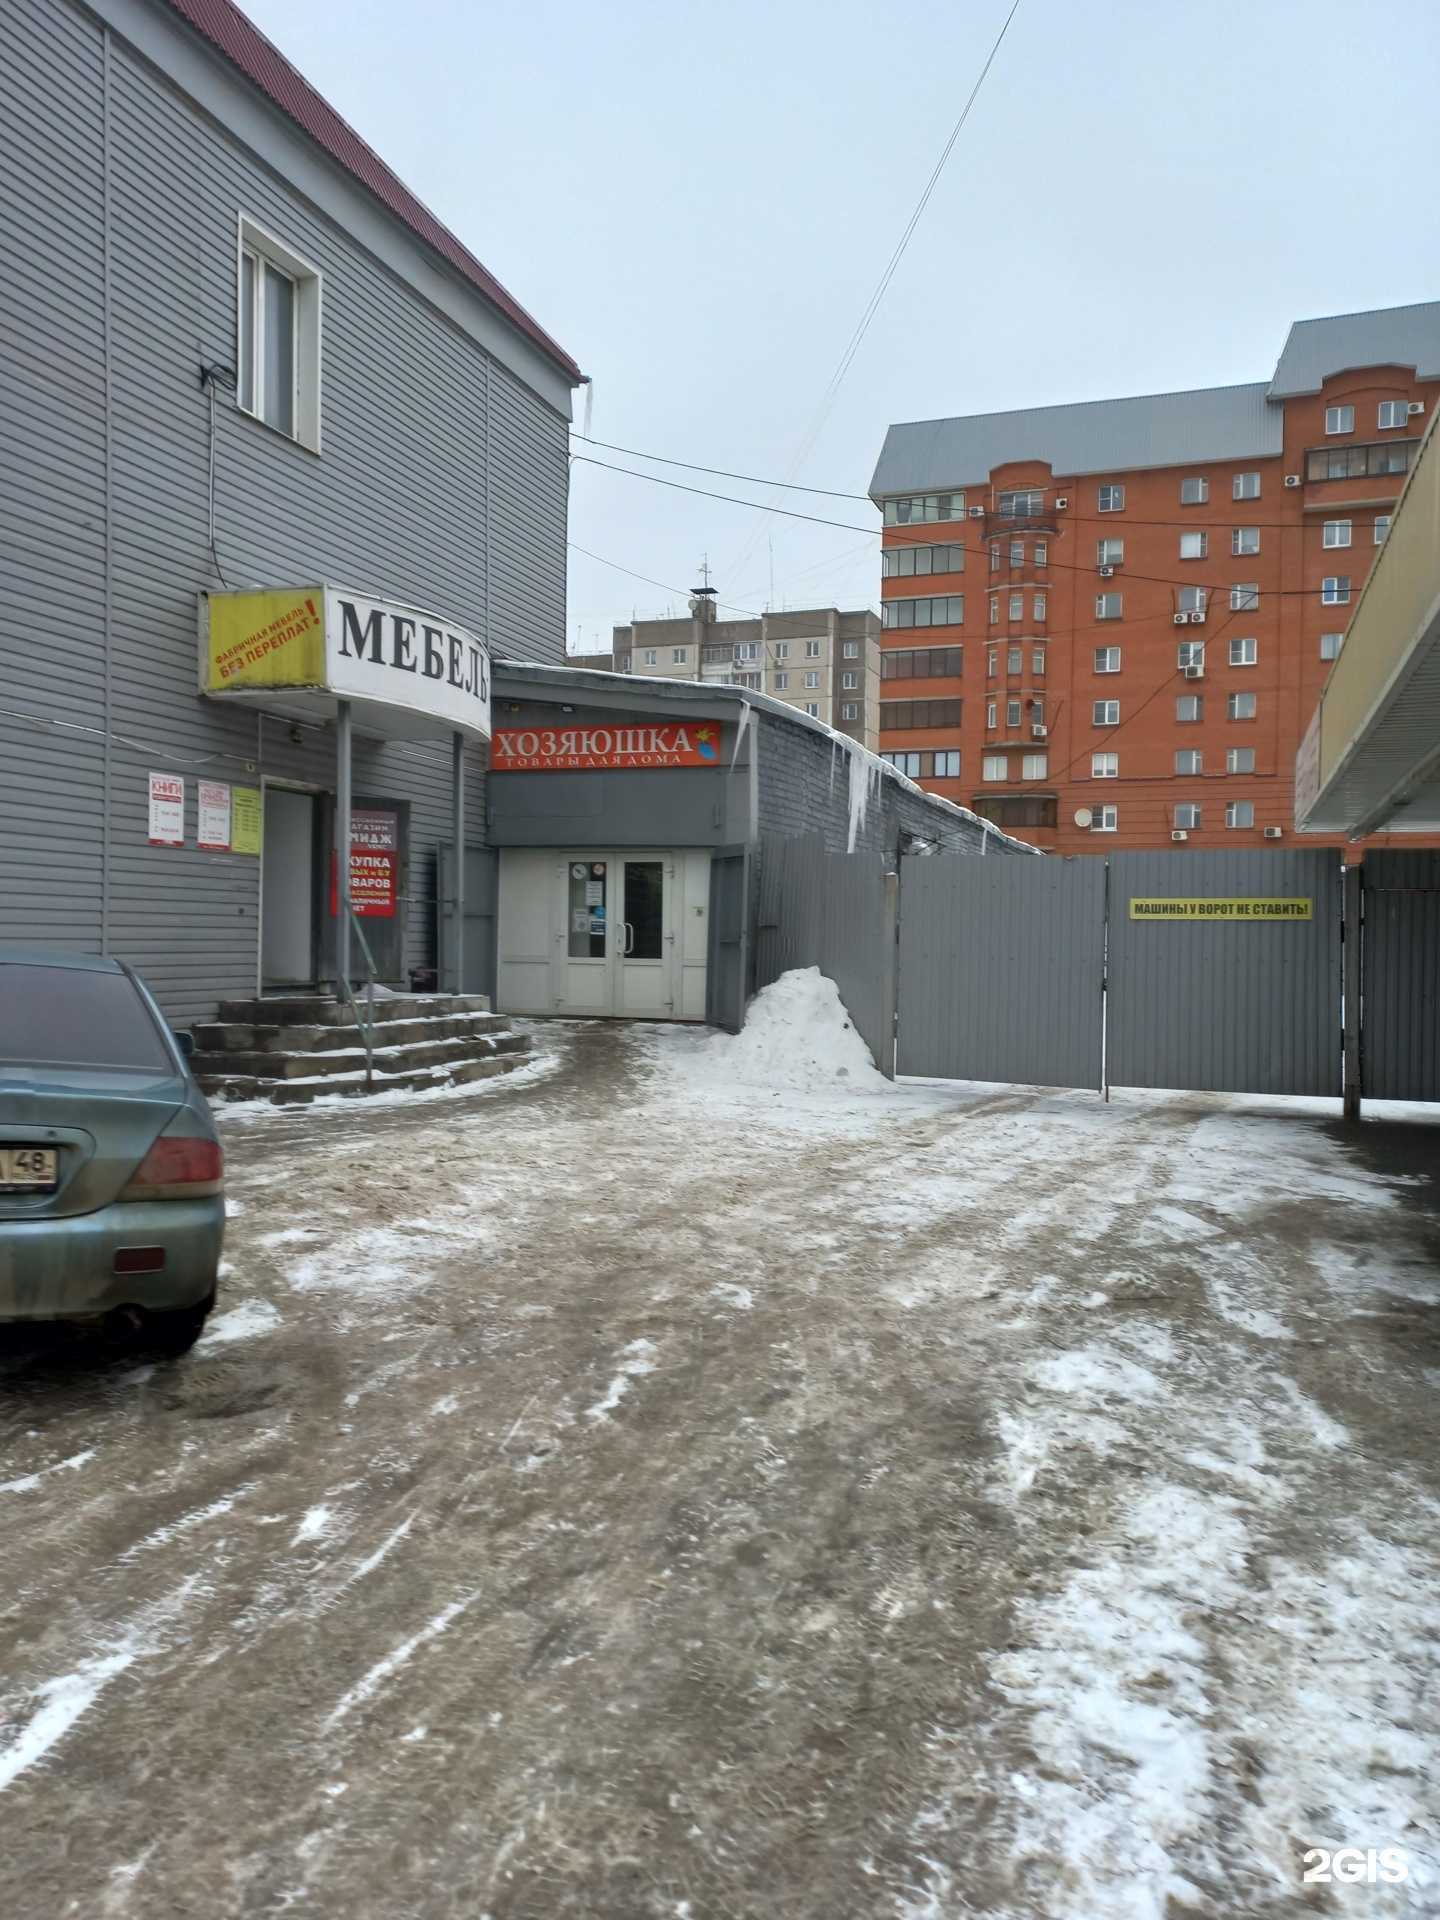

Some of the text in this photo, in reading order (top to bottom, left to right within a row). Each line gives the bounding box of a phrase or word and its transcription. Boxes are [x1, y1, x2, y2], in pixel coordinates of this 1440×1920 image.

[269, 607, 304, 633] МЕБЕЛЬ
[337, 600, 488, 704] МЕБЕЛЬ
[496, 727, 694, 757] ХОЗЯЮШКА
[506, 754, 681, 767] ТОВАРЫ ДЛЯ ДОМА
[350, 856, 391, 868] КУПКА
[351, 878, 391, 888] ВАРОВ
[1135, 903, 1309, 915] МАШИНЫ У ВОРОТ НЕ СТАВИТЬ!
[16, 1151, 46, 1172] 48
